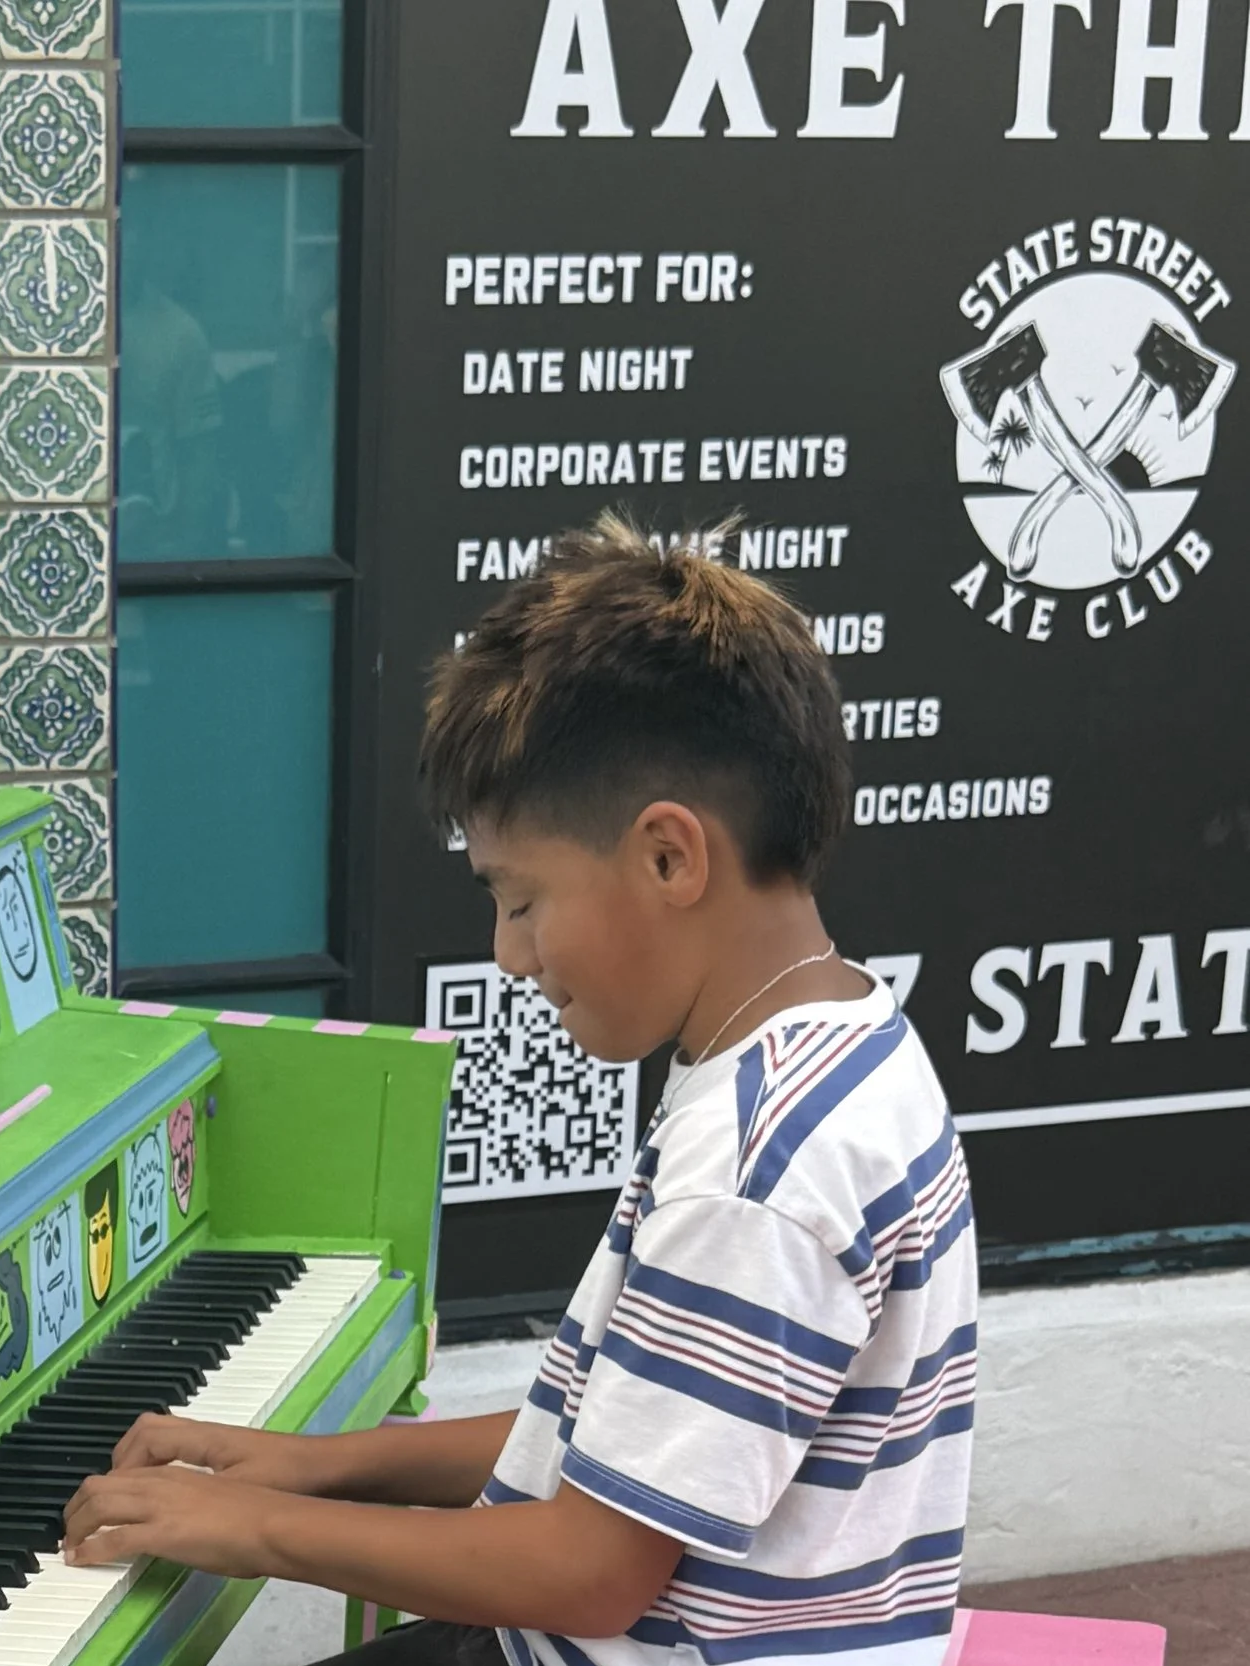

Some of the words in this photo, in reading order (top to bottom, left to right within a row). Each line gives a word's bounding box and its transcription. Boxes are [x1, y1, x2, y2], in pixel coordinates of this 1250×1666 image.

[510, 0, 905, 138] AXE
[984, 0, 1250, 141] TH
[446, 255, 642, 306] PERFECT
[655, 254, 754, 302] FOR:
[958, 219, 1080, 331] STATE
[1089, 217, 1232, 322] STREET
[463, 351, 565, 394] DATE
[579, 347, 693, 392] NIGHT
[460, 442, 686, 489] CORPORATE
[699, 437, 848, 482] EVENTS
[739, 526, 849, 570] NIGHT
[950, 560, 1058, 642] AXE
[1085, 529, 1214, 639] CLUB
[841, 697, 940, 741] RTIES
[854, 776, 1052, 825] OCCASIONS
[865, 953, 923, 1010] 7
